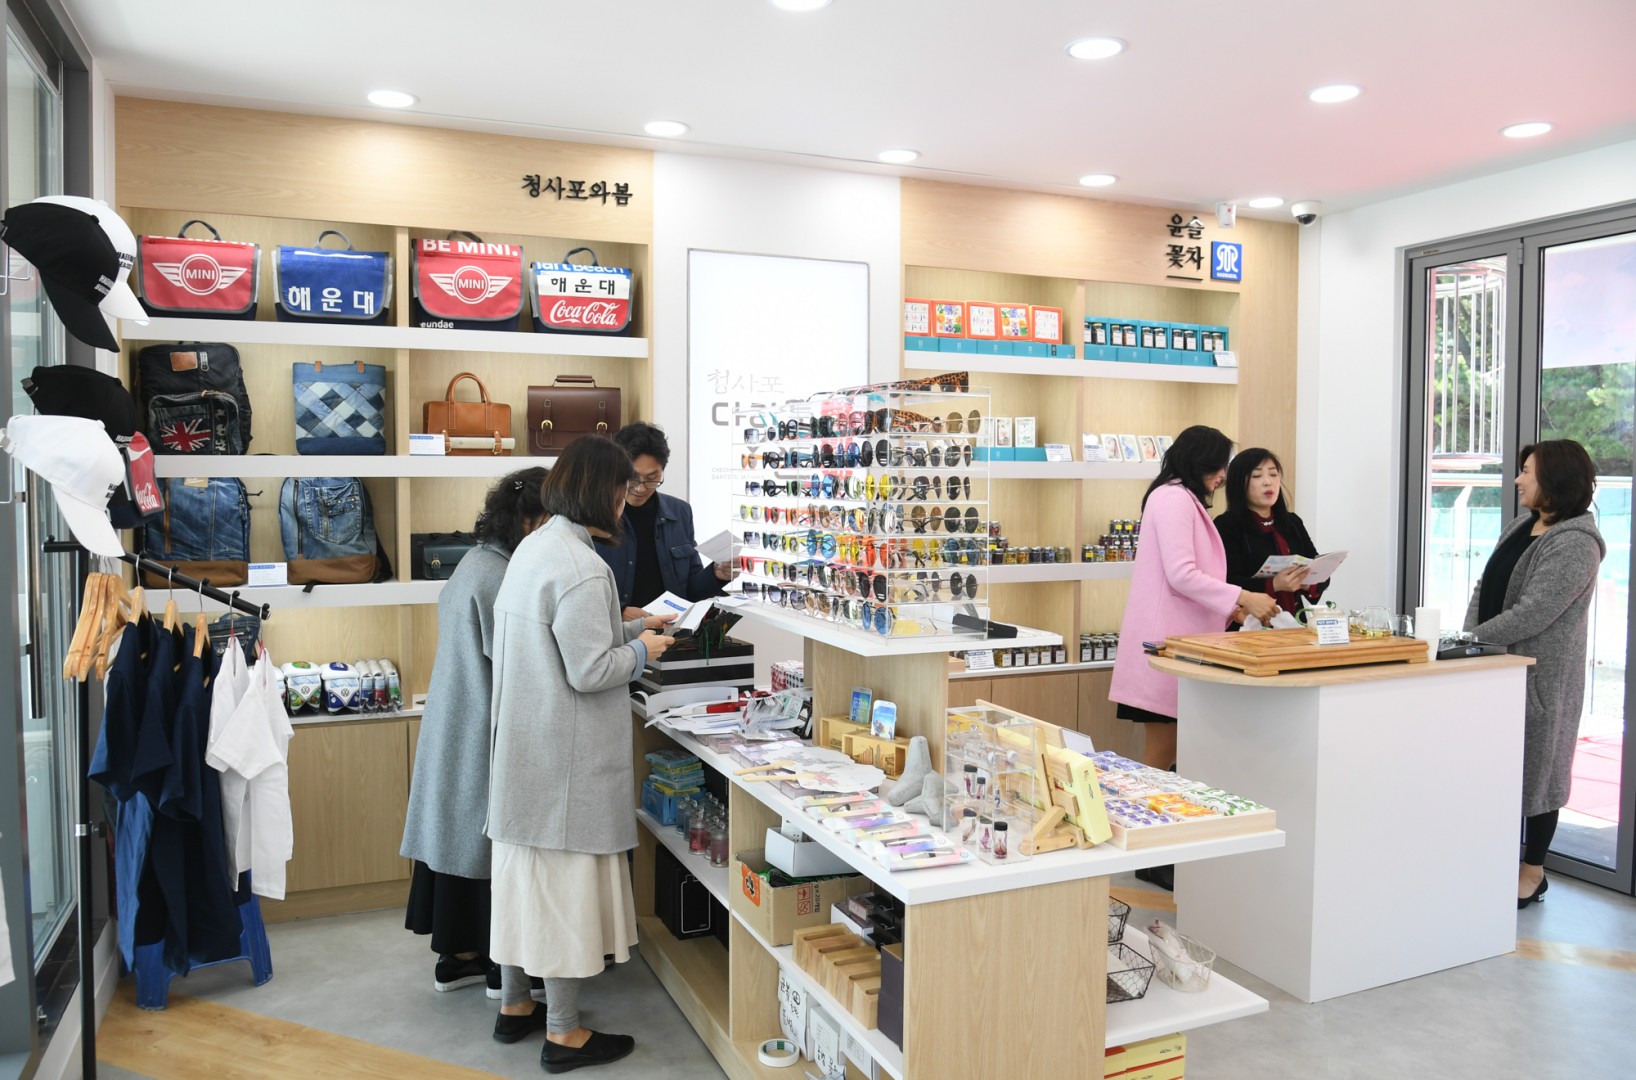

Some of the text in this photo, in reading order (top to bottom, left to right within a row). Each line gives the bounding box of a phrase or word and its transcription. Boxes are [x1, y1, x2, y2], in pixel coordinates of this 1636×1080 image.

[521, 174, 633, 207] 청사포와봄
[422, 238, 451, 252] BE
[1165, 244, 1205, 271] 꽃차
[185, 268, 216, 280] MINI
[458, 278, 486, 290] MINI
[706, 368, 785, 395] 청사포
